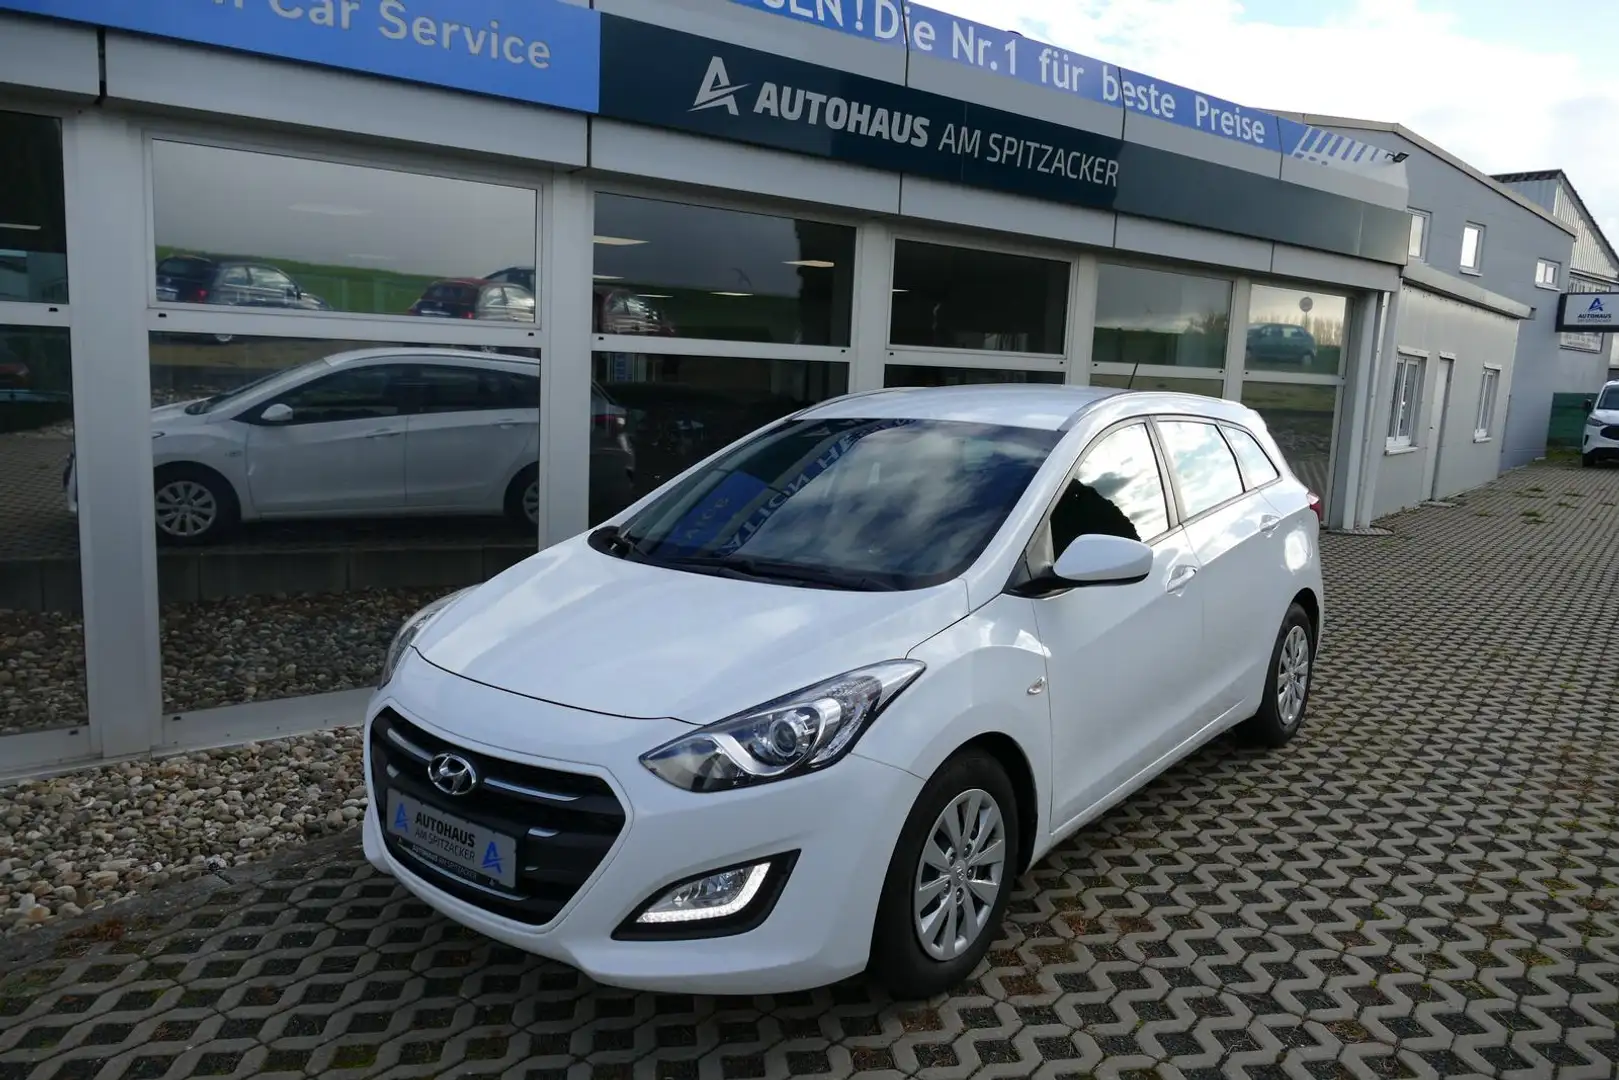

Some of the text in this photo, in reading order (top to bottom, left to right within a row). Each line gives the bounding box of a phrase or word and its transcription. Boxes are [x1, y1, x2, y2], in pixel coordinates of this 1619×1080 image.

[379, 3, 552, 69] Service
[1039, 48, 1085, 92] für
[1102, 64, 1176, 119] beste
[1195, 95, 1265, 144] Preise
[753, 82, 931, 148] AUTOHAUS
[938, 123, 982, 159] AM
[986, 132, 1119, 187] SPITZACKER
[414, 811, 476, 848] AUTOHAUS
[428, 832, 476, 864] SPITZACKER
